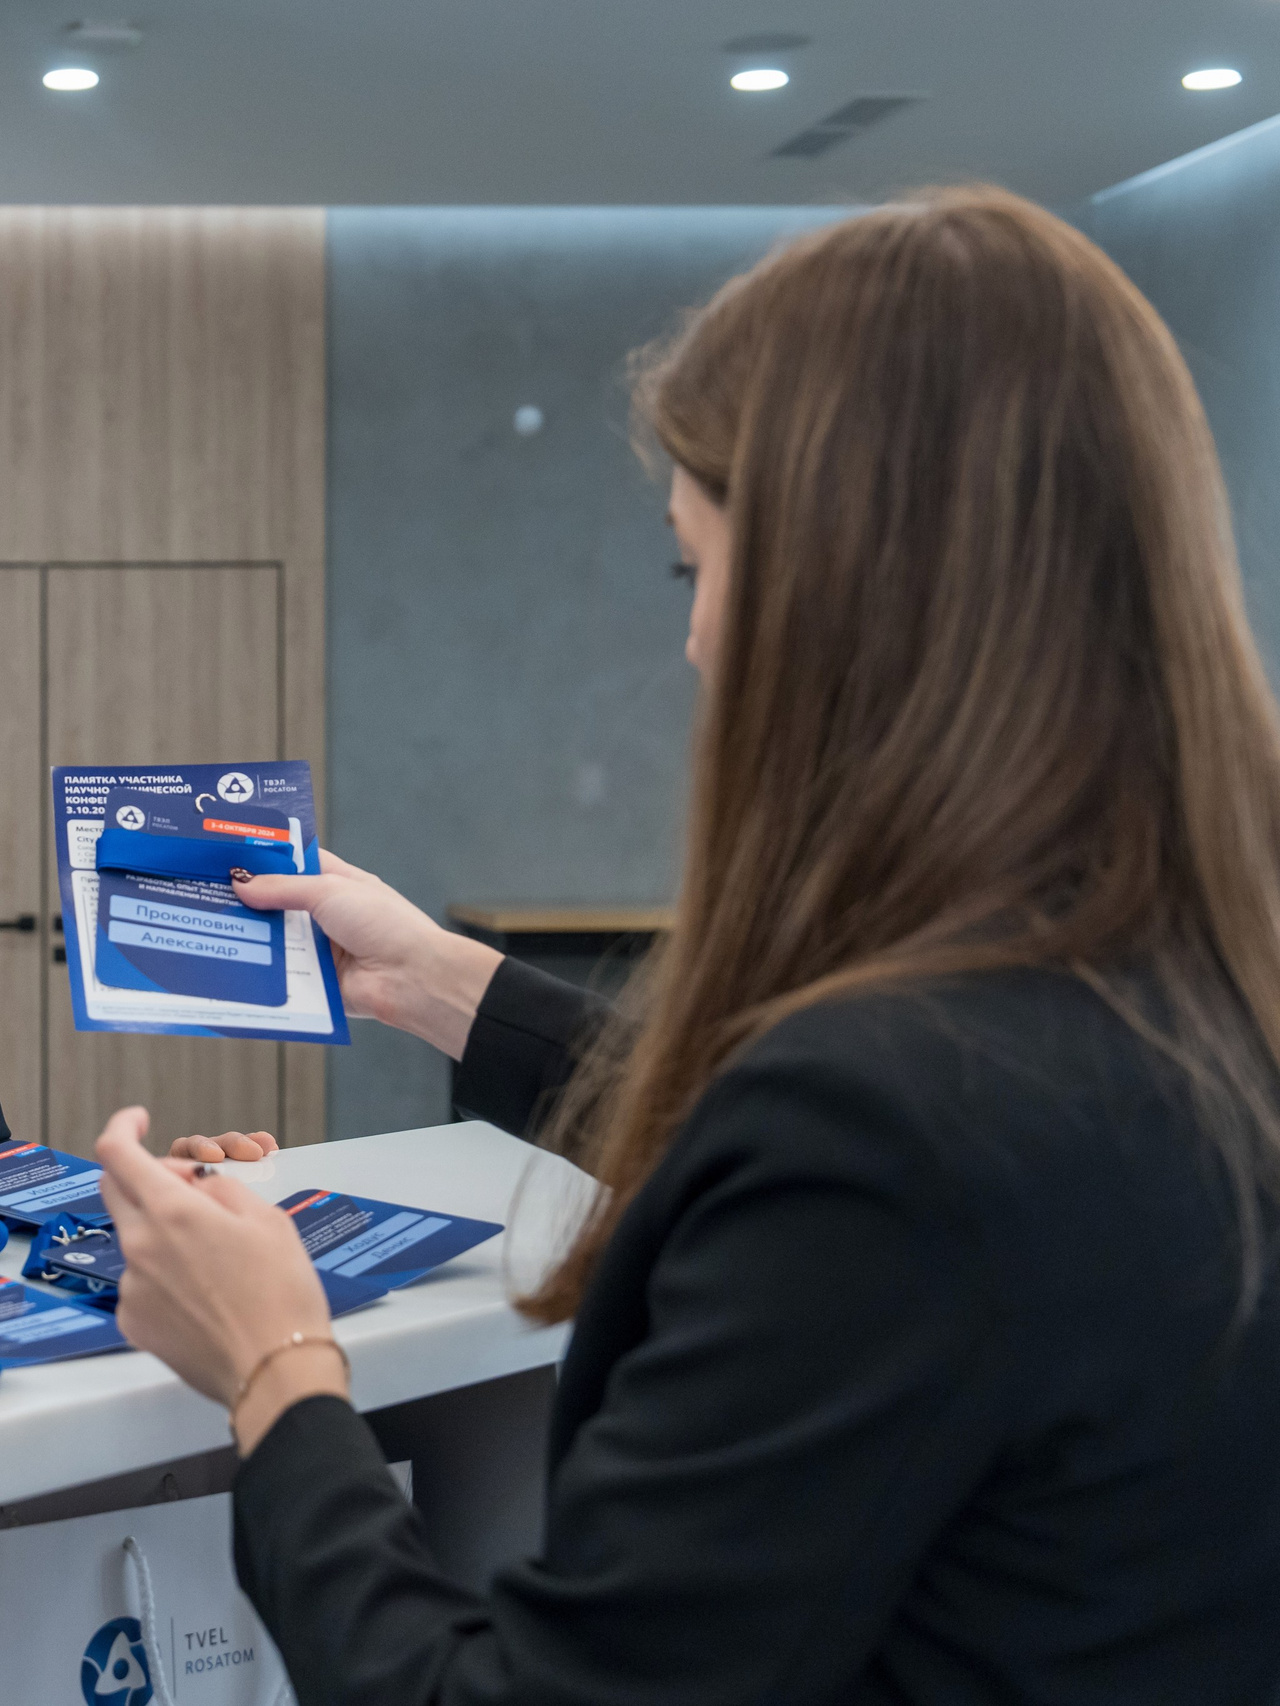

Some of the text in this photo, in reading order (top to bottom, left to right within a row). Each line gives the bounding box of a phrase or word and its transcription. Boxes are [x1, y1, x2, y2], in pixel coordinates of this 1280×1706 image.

[64, 775, 183, 784] ПАМЯТКА УЧАСТНИКА
[136, 904, 245, 933] Прокопович
[141, 931, 239, 958] Александр
[184, 1626, 228, 1650] TVEL
[185, 1647, 255, 1675] ROSATOM
